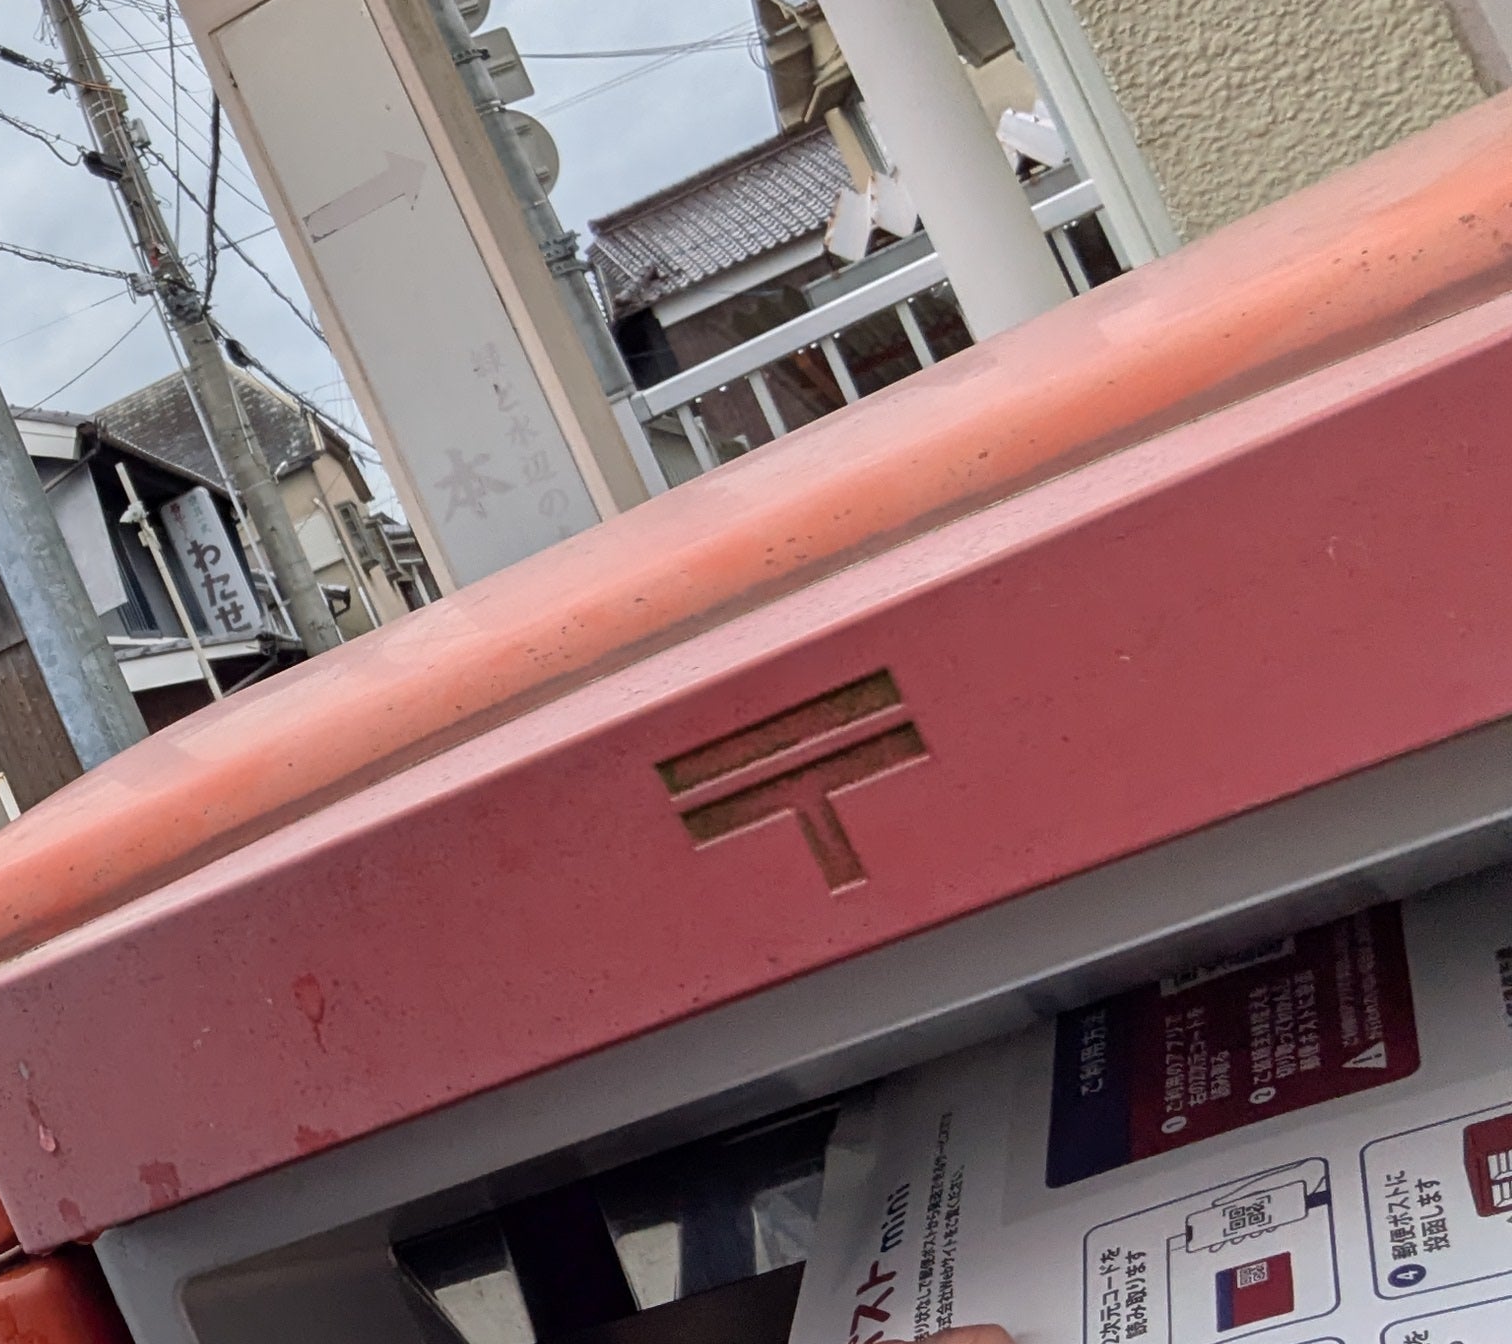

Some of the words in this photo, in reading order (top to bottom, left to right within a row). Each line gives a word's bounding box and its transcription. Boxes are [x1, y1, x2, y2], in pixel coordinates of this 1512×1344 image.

[187, 540, 252, 632] わたせ
[880, 1183, 910, 1253] mini
[1384, 1169, 1419, 1261] 郵便ポストに
[1414, 1177, 1451, 1254] 投函します
[1124, 1250, 1148, 1340] 読み取ります
